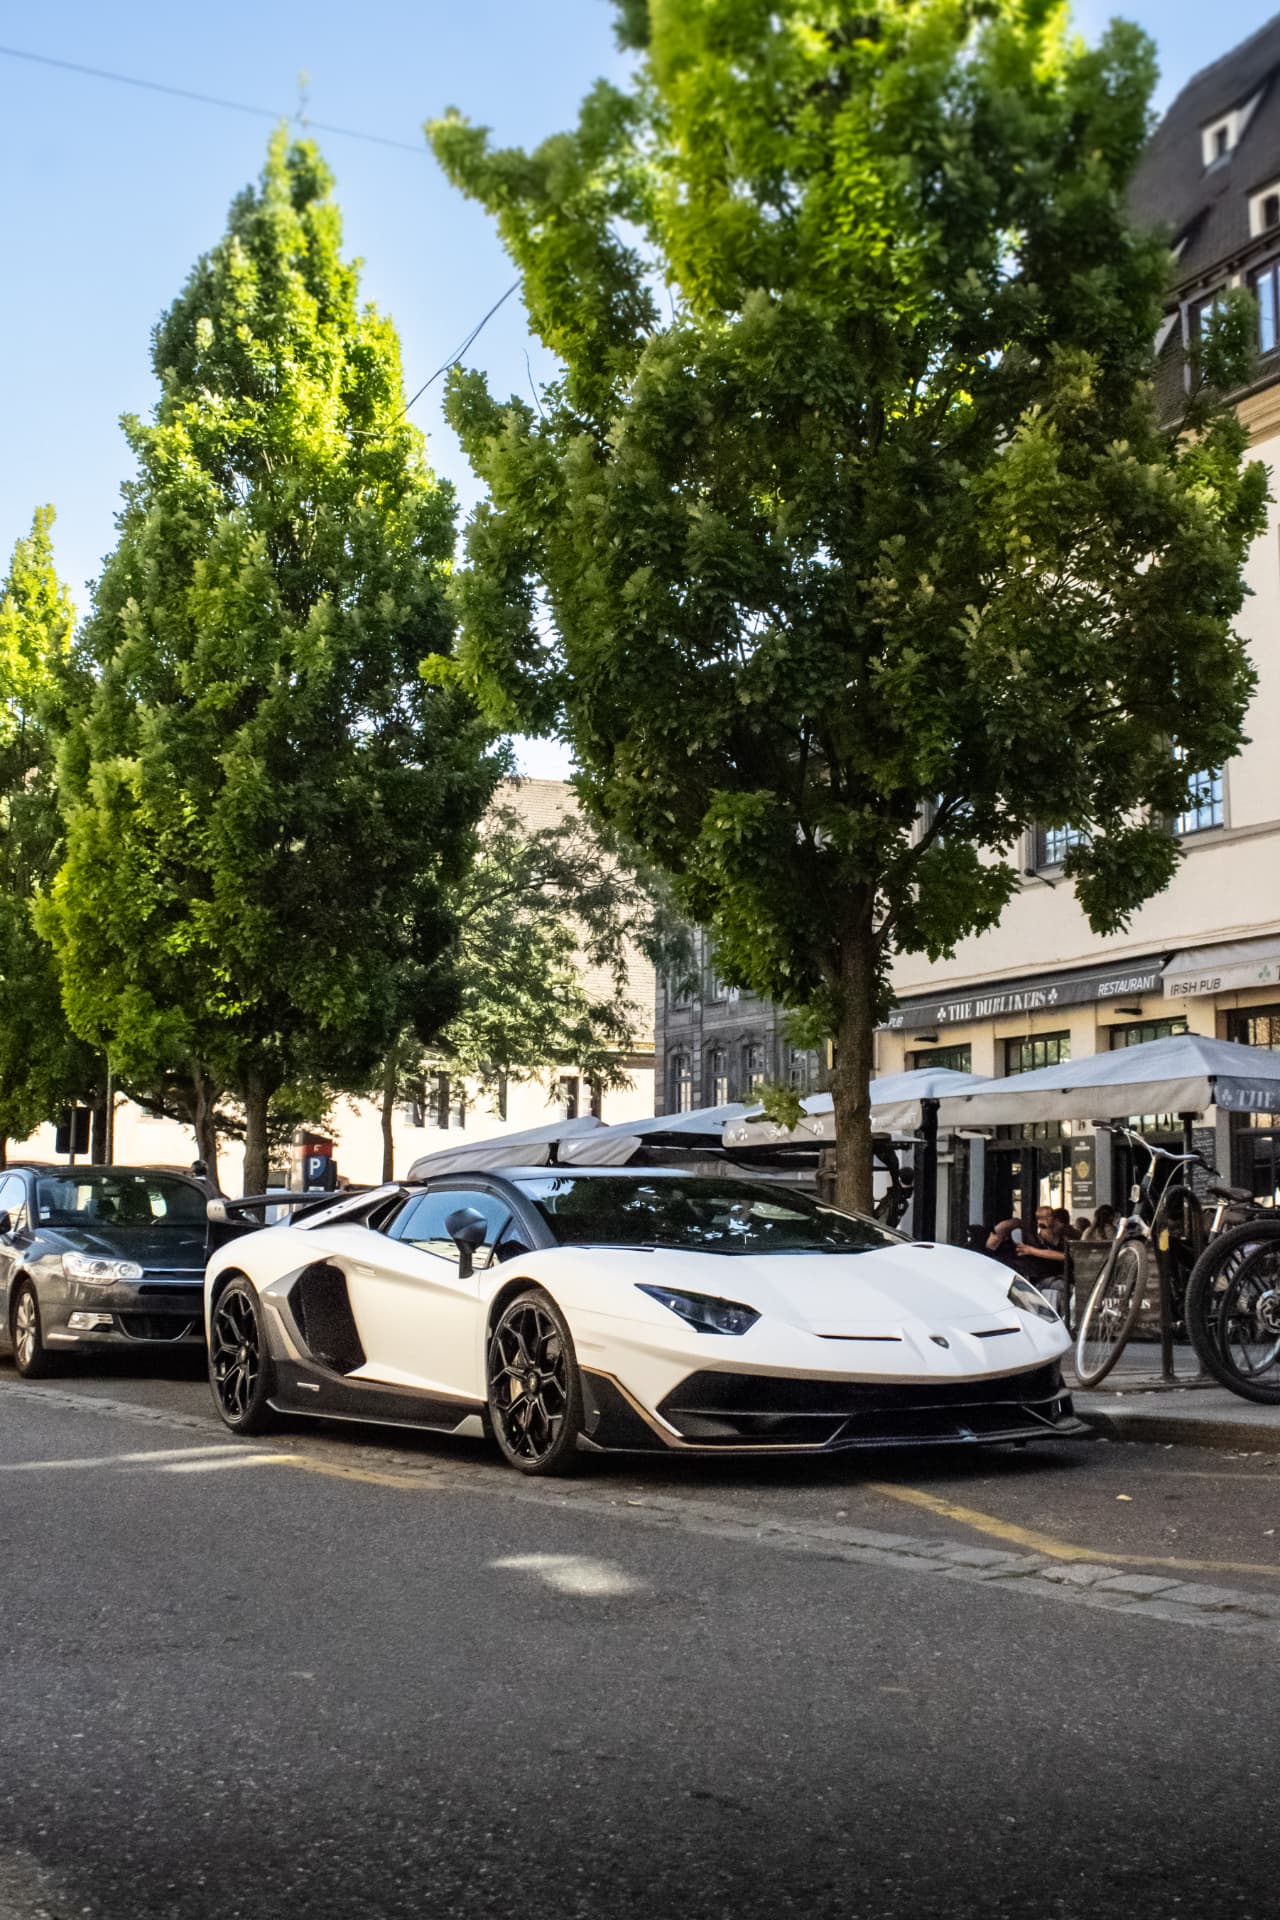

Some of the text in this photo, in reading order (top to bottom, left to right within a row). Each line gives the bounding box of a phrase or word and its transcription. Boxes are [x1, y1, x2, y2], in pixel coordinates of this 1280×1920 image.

[1098, 975, 1156, 997] RESTAURANT
[1170, 977, 1221, 997] IRISH PUB
[948, 991, 1046, 1021] THE DUBLINERS
[309, 1157, 321, 1176] P
